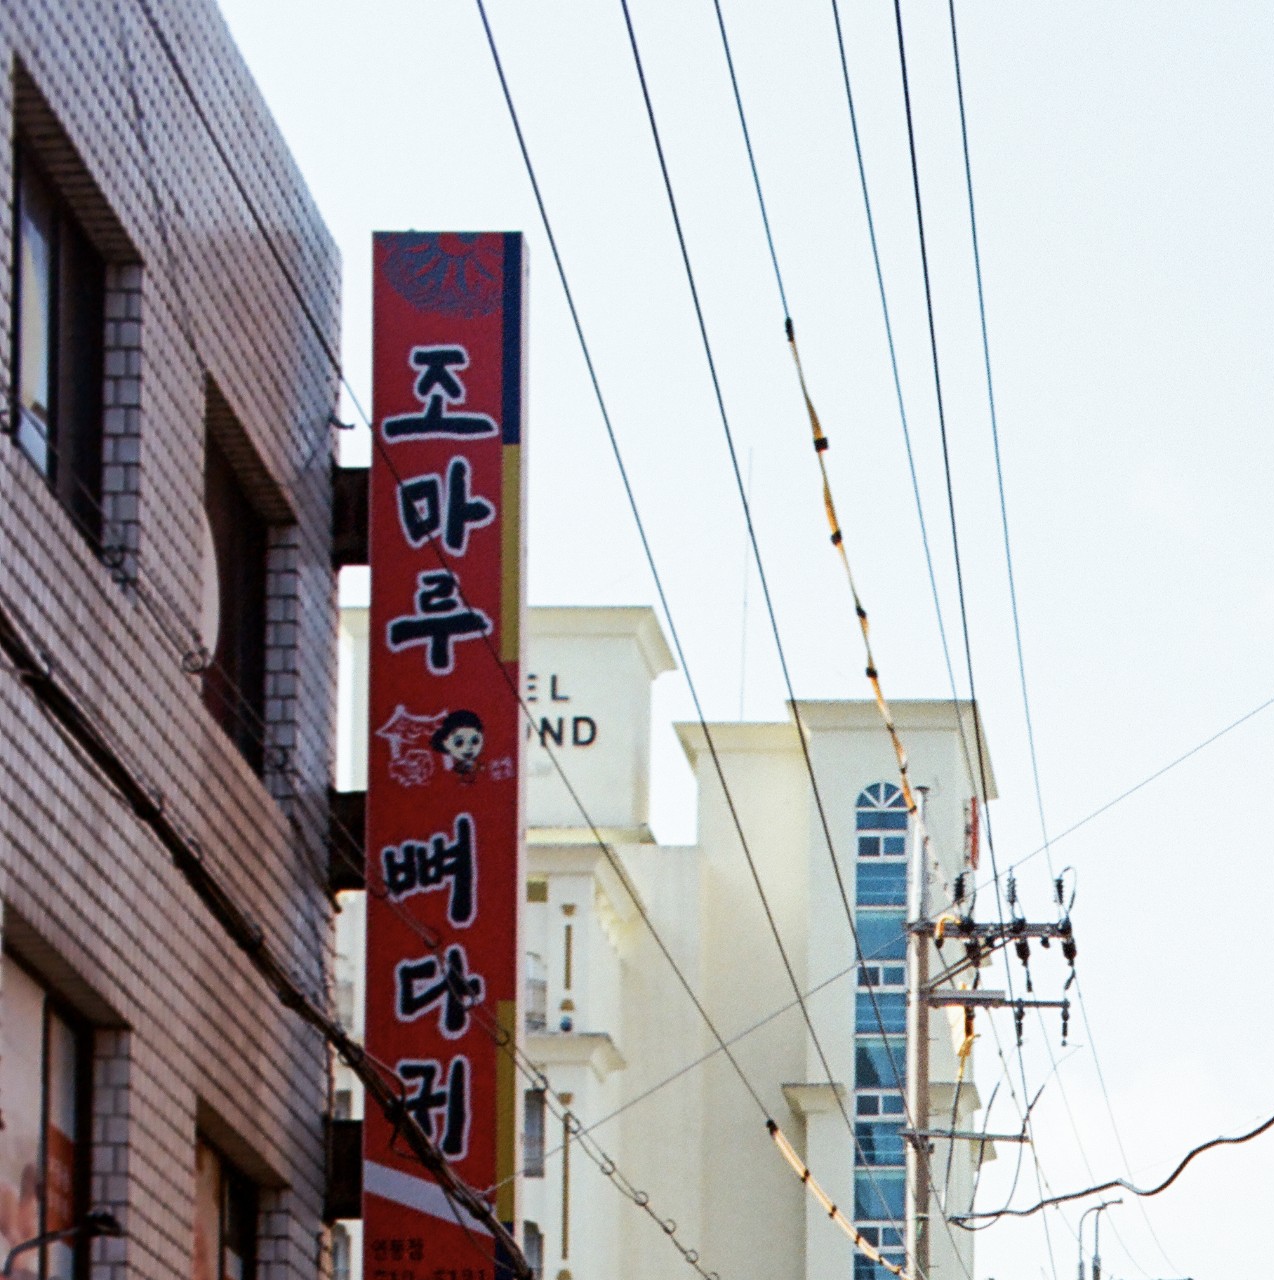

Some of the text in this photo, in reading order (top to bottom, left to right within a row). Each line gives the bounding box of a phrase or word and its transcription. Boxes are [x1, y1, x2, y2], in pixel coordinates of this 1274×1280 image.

[382, 344, 500, 676] 조마루
[526, 715, 598, 748] ND
[381, 812, 484, 1161] 뼈다귀
